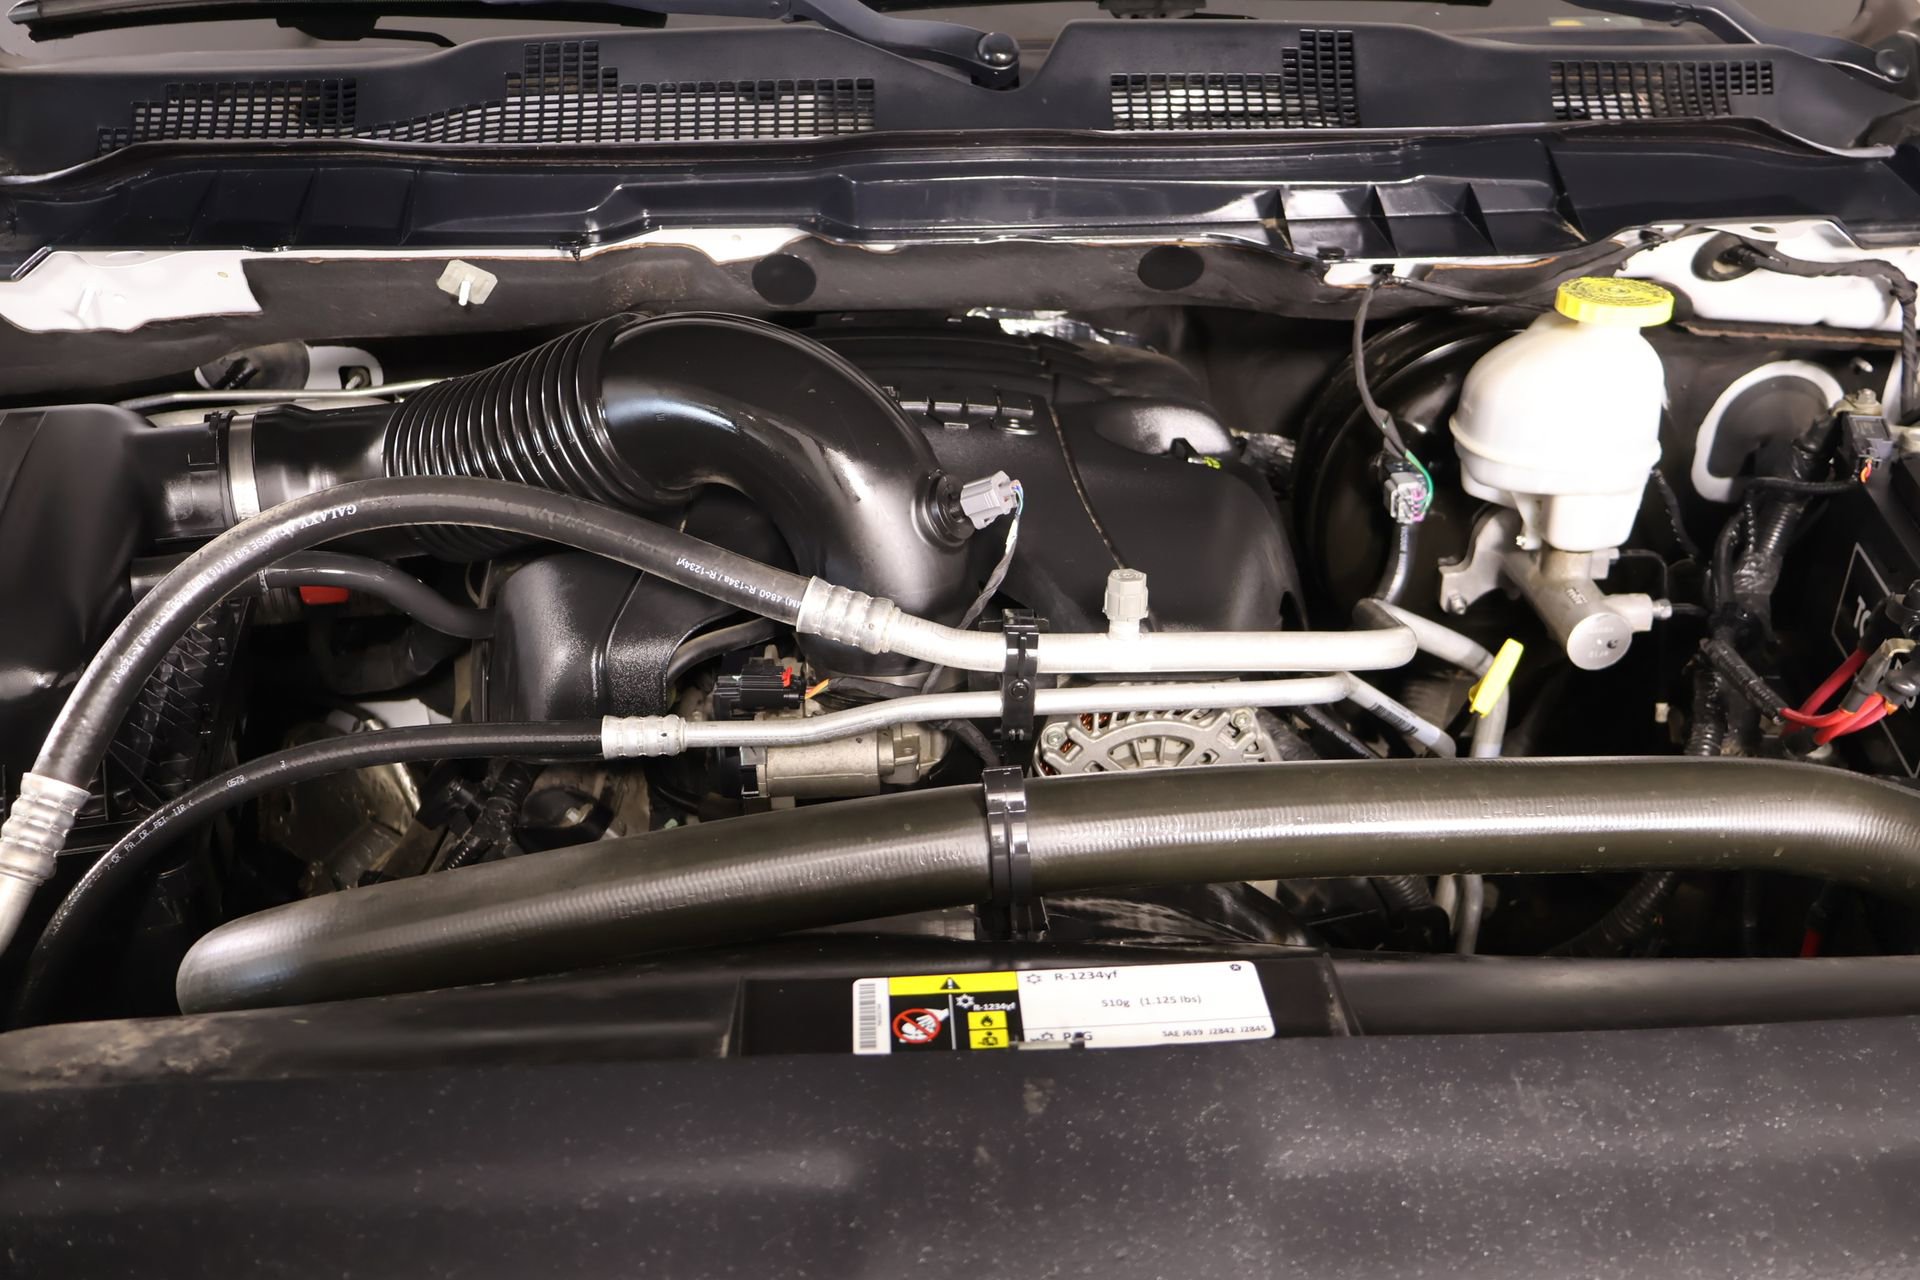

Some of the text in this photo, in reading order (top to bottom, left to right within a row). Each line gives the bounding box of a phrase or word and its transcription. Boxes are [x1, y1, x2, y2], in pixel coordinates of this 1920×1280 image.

[300, 504, 357, 530] GALAXY
[251, 533, 279, 551] HOSE
[224, 555, 237, 566] IN
[234, 548, 250, 560] 5/8
[676, 556, 718, 580] R-1234yf
[723, 574, 757, 595] R-134a
[759, 588, 784, 605] 4860
[1054, 970, 1118, 981] R-1234yf
[1101, 998, 1131, 1008] 510g
[1140, 995, 1178, 1007] (1.125
[1063, 1031, 1093, 1041] PG
